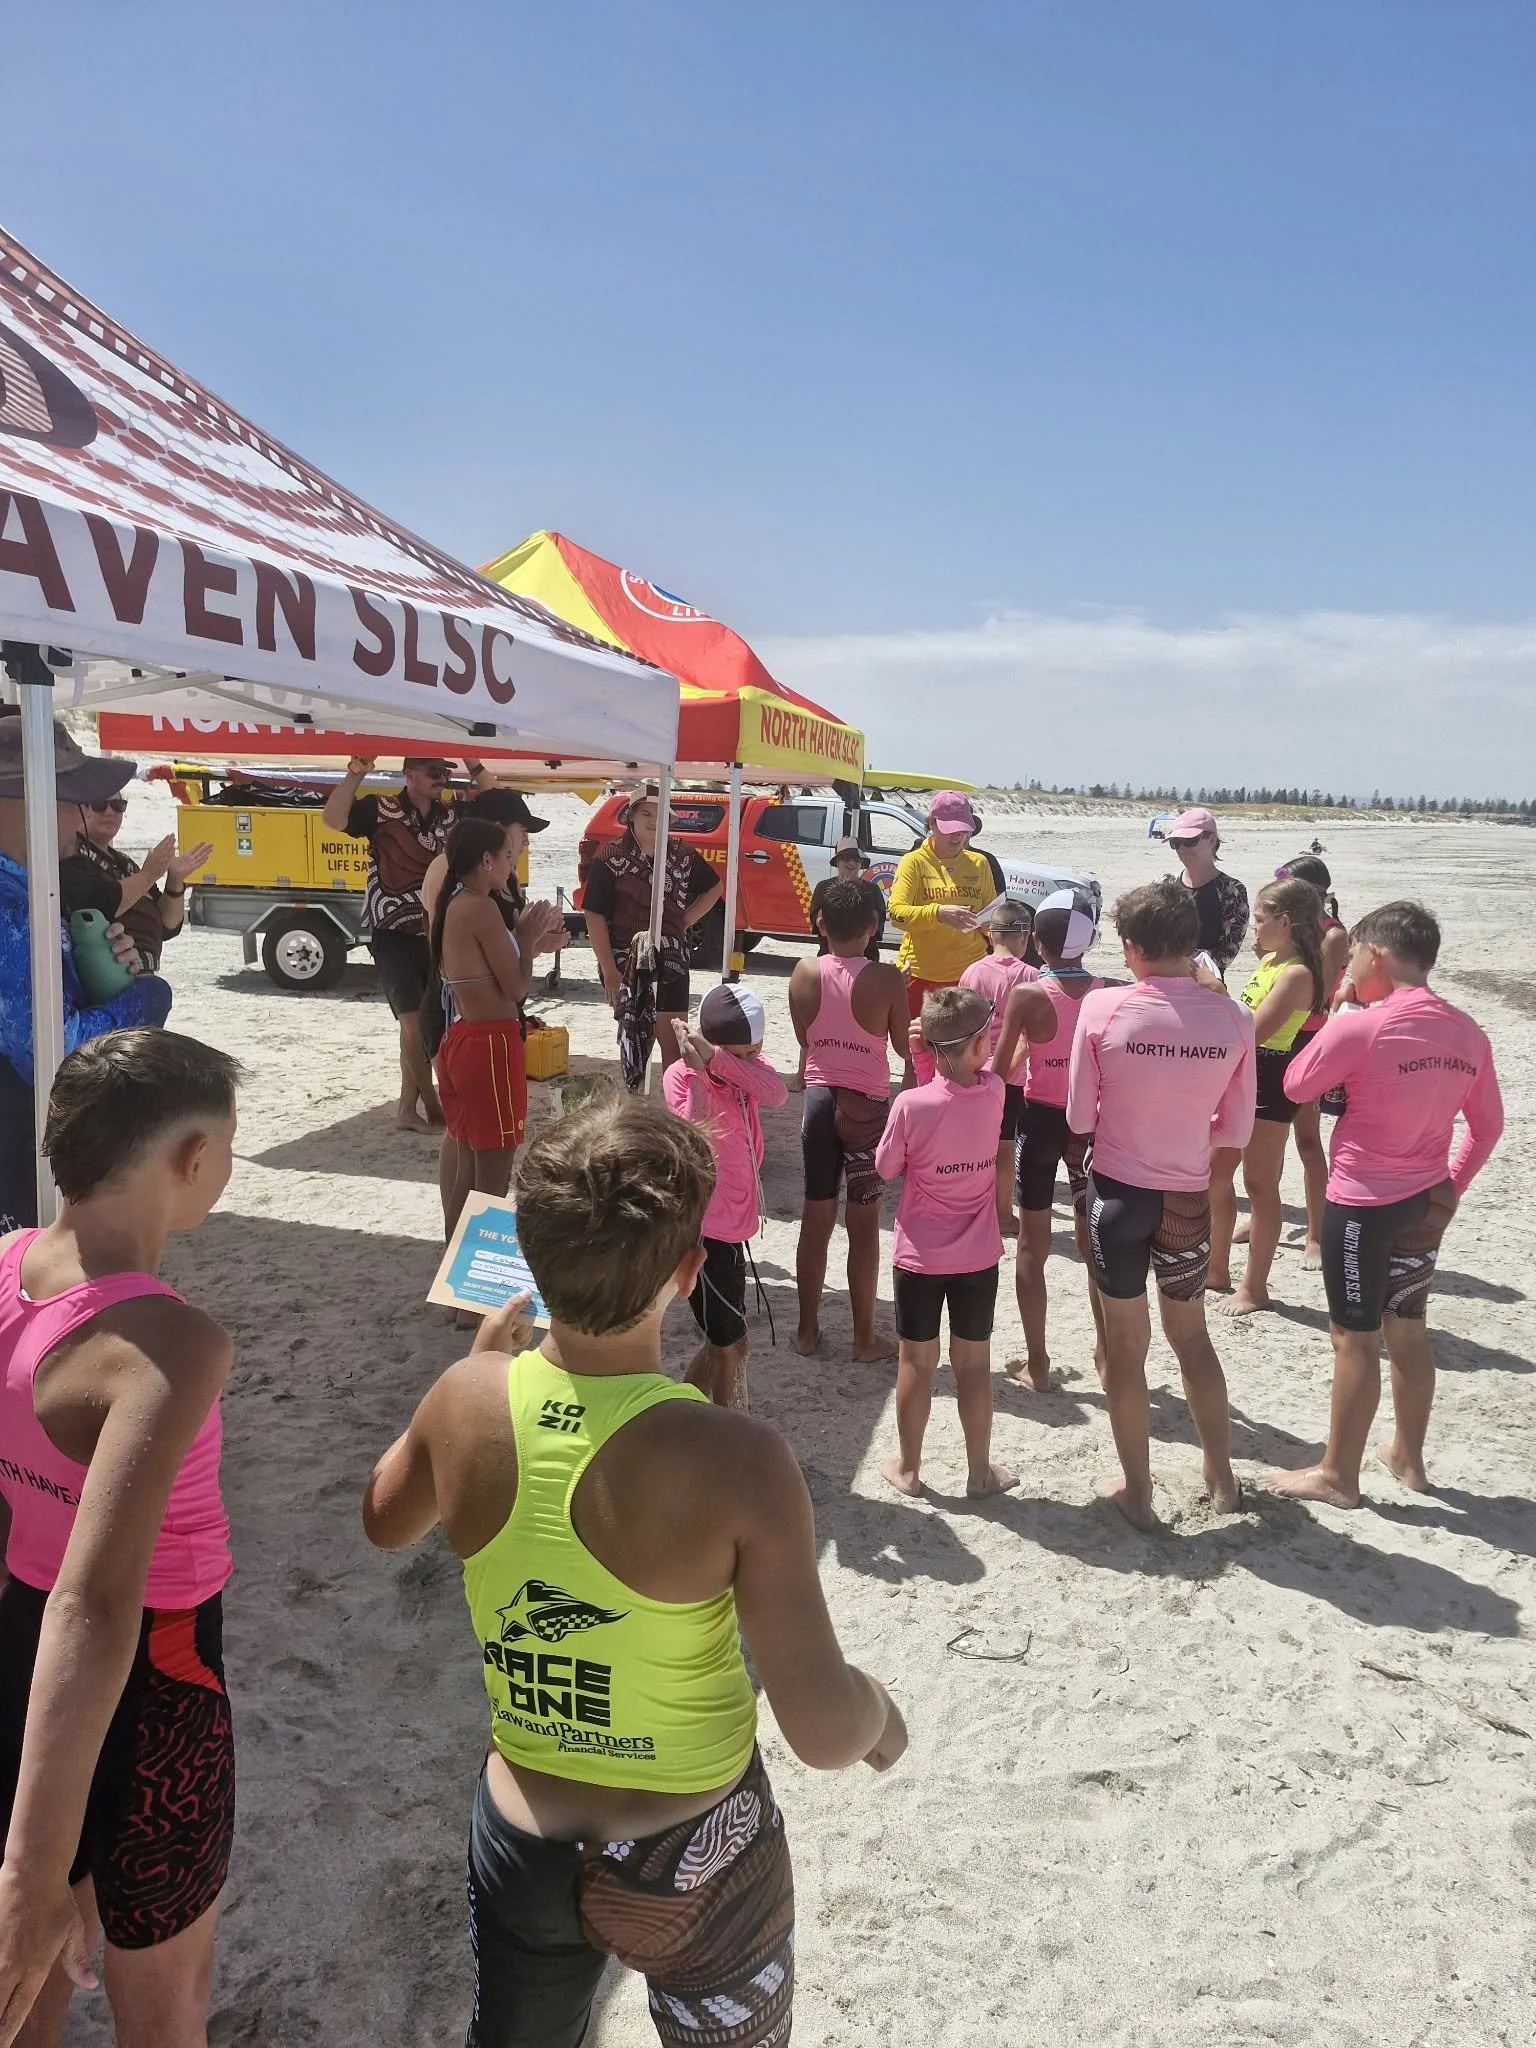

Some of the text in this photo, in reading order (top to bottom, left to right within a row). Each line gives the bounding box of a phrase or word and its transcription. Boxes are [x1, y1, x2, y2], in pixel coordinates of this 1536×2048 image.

[345, 584, 516, 704] SLSC
[761, 703, 859, 768] NORTH HAVEN SLSC
[321, 842, 359, 855] NORTH
[327, 859, 350, 872] LIFE
[1009, 874, 1045, 888] Haven
[922, 886, 982, 901] SURF RESCUE
[1006, 884, 1050, 897] aving Club
[813, 1038, 871, 1055] NORTH HAVEN
[1125, 1041, 1228, 1060] NORTH HAVEN
[1044, 1058, 1070, 1068] NORT
[1398, 1056, 1441, 1076] NORTH
[936, 1162, 974, 1174] NORTH
[1090, 1197, 1105, 1230] NORTH
[479, 1228, 499, 1241] THE
[1343, 1220, 1362, 1303] NORTH HAVEN SLSC
[541, 1400, 586, 1418] KO
[484, 1640, 611, 1696] RACE
[508, 1680, 611, 1727] ONE
[558, 1742, 656, 1761] Financial Services
